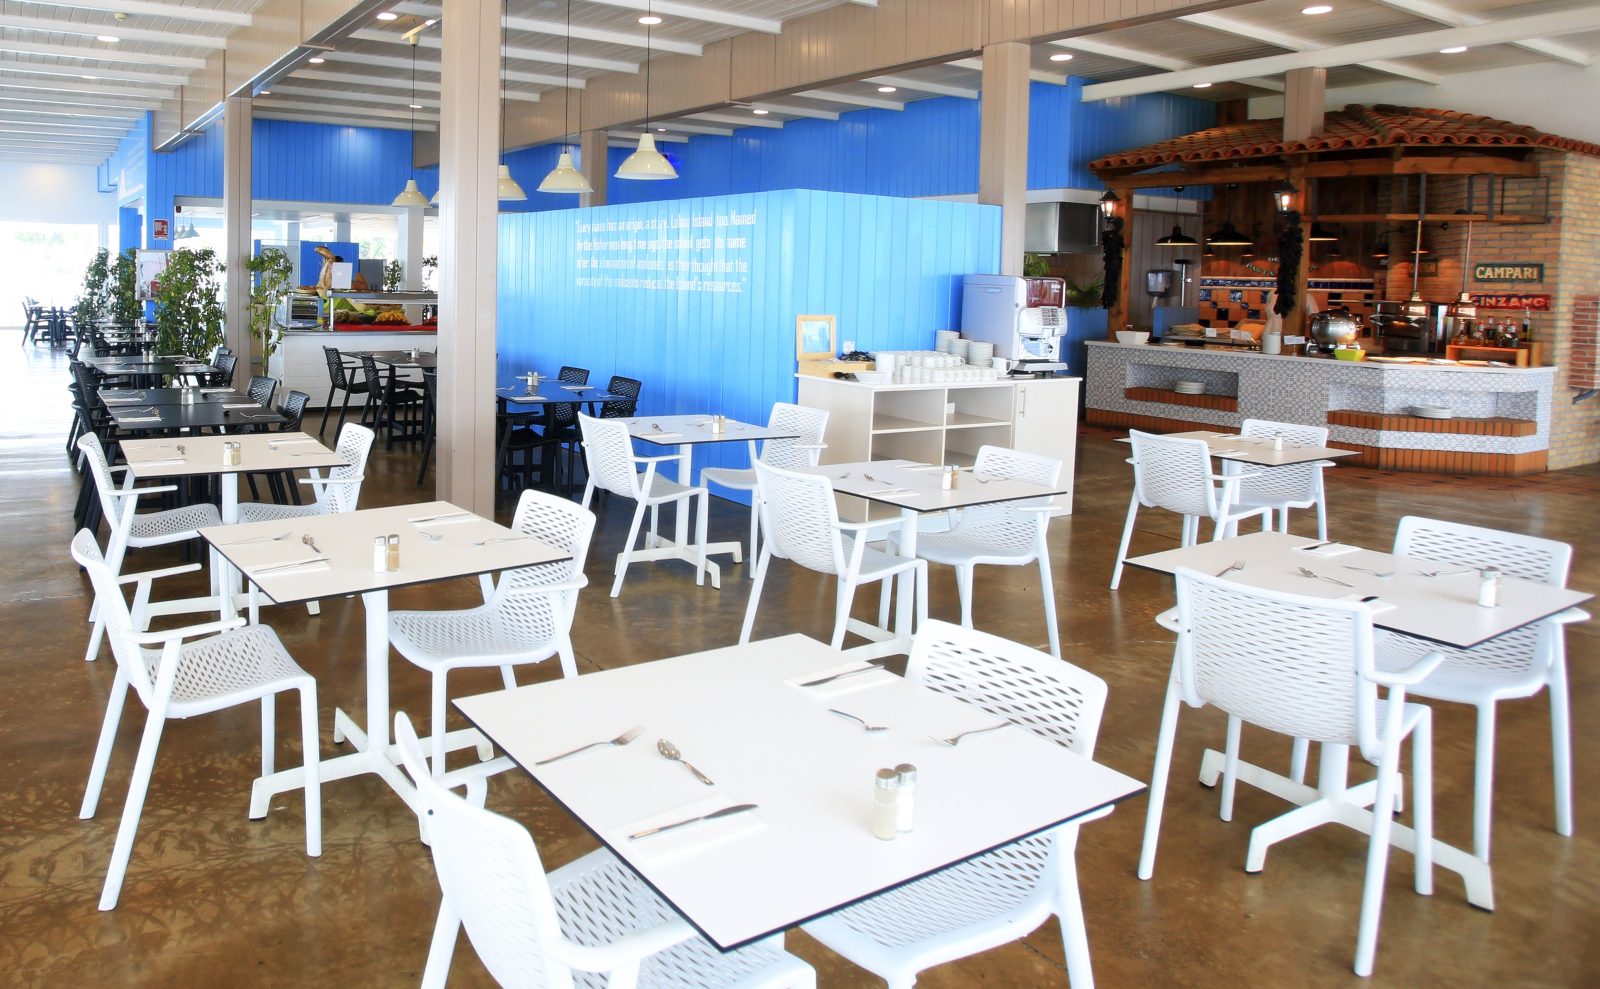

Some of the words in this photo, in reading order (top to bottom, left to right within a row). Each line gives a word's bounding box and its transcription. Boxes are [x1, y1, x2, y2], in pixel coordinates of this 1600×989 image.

[730, 208, 757, 226] Named
[736, 256, 748, 272] the
[1476, 266, 1538, 279] CAMPARI
